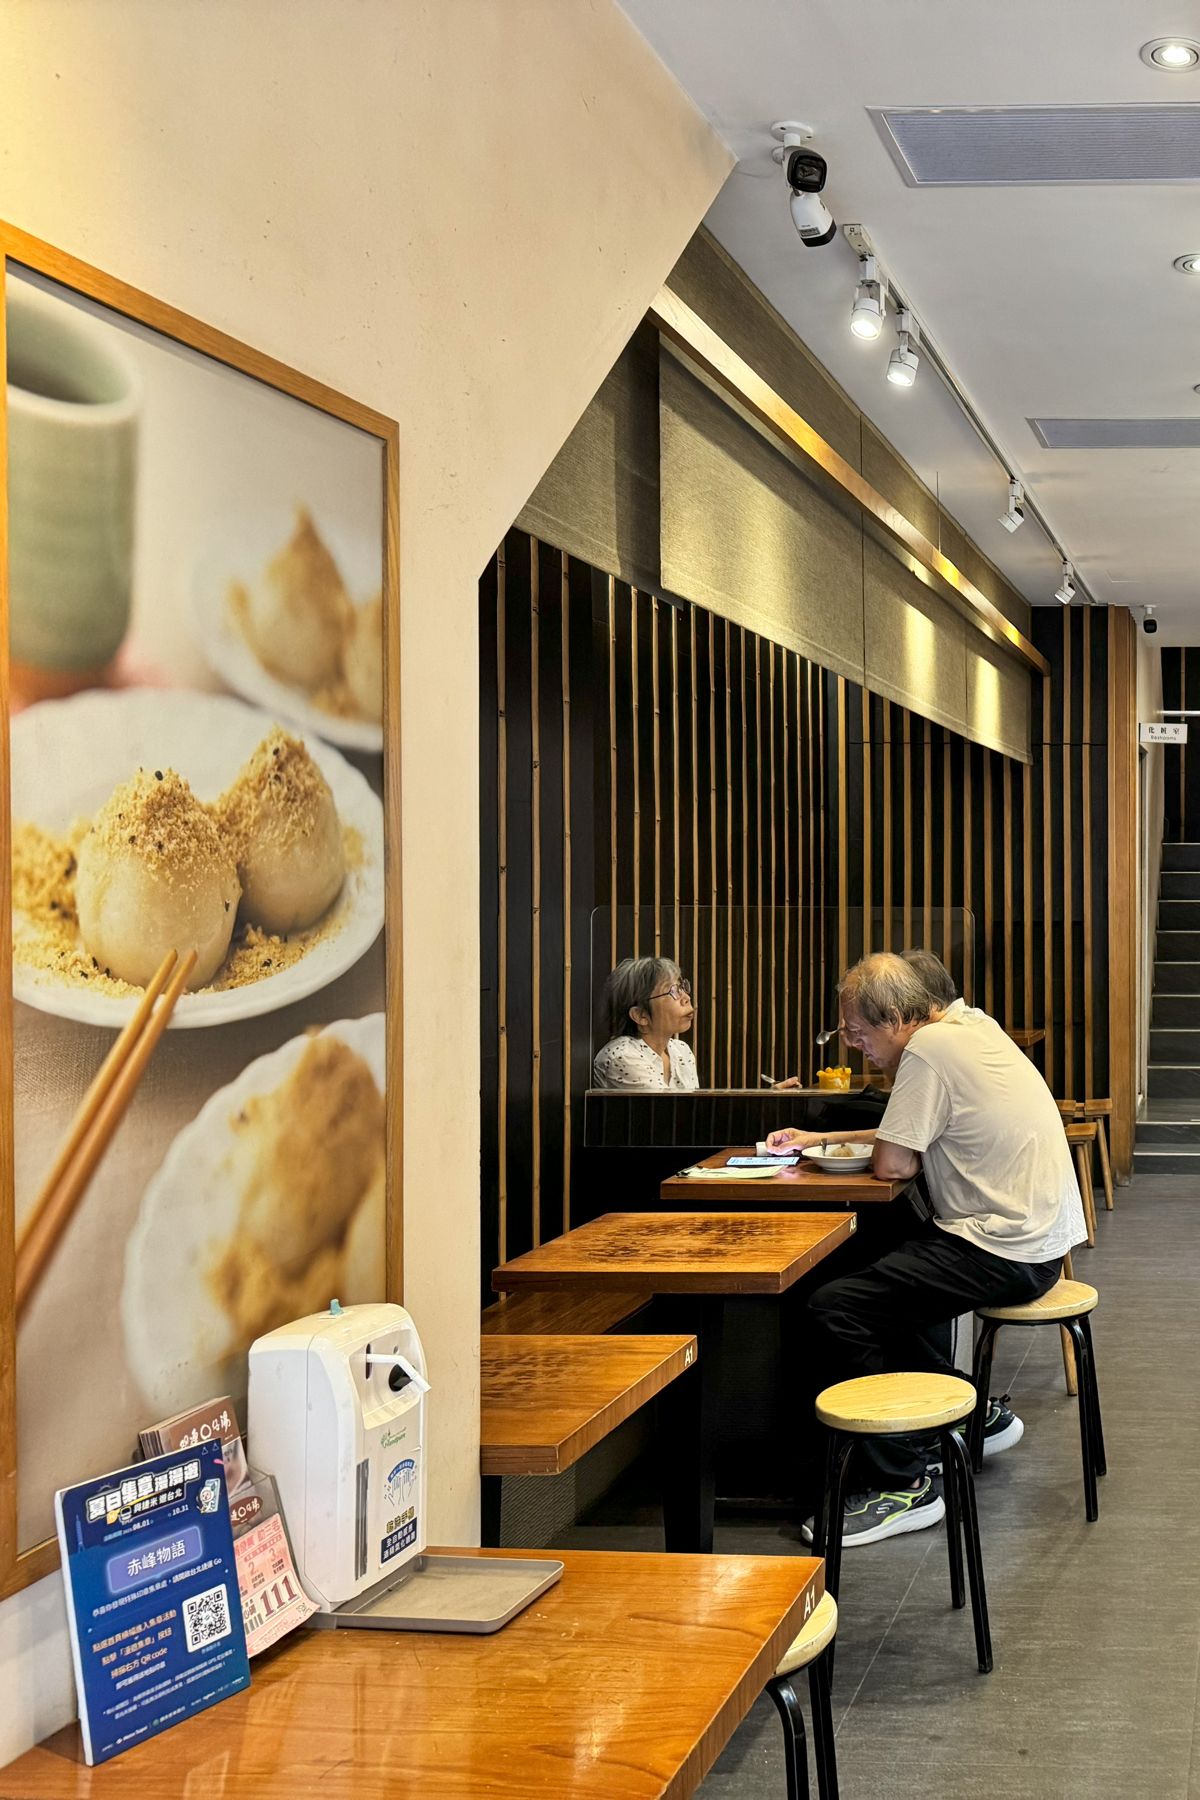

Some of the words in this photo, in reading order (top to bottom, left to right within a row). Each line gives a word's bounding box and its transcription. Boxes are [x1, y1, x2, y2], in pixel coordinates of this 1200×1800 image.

[685, 1345, 693, 1367] A1
[127, 1539, 186, 1577] 赤峰物語
[260, 1575, 297, 1618] 111
[804, 1584, 815, 1620] A1
[151, 1647, 168, 1660] code
